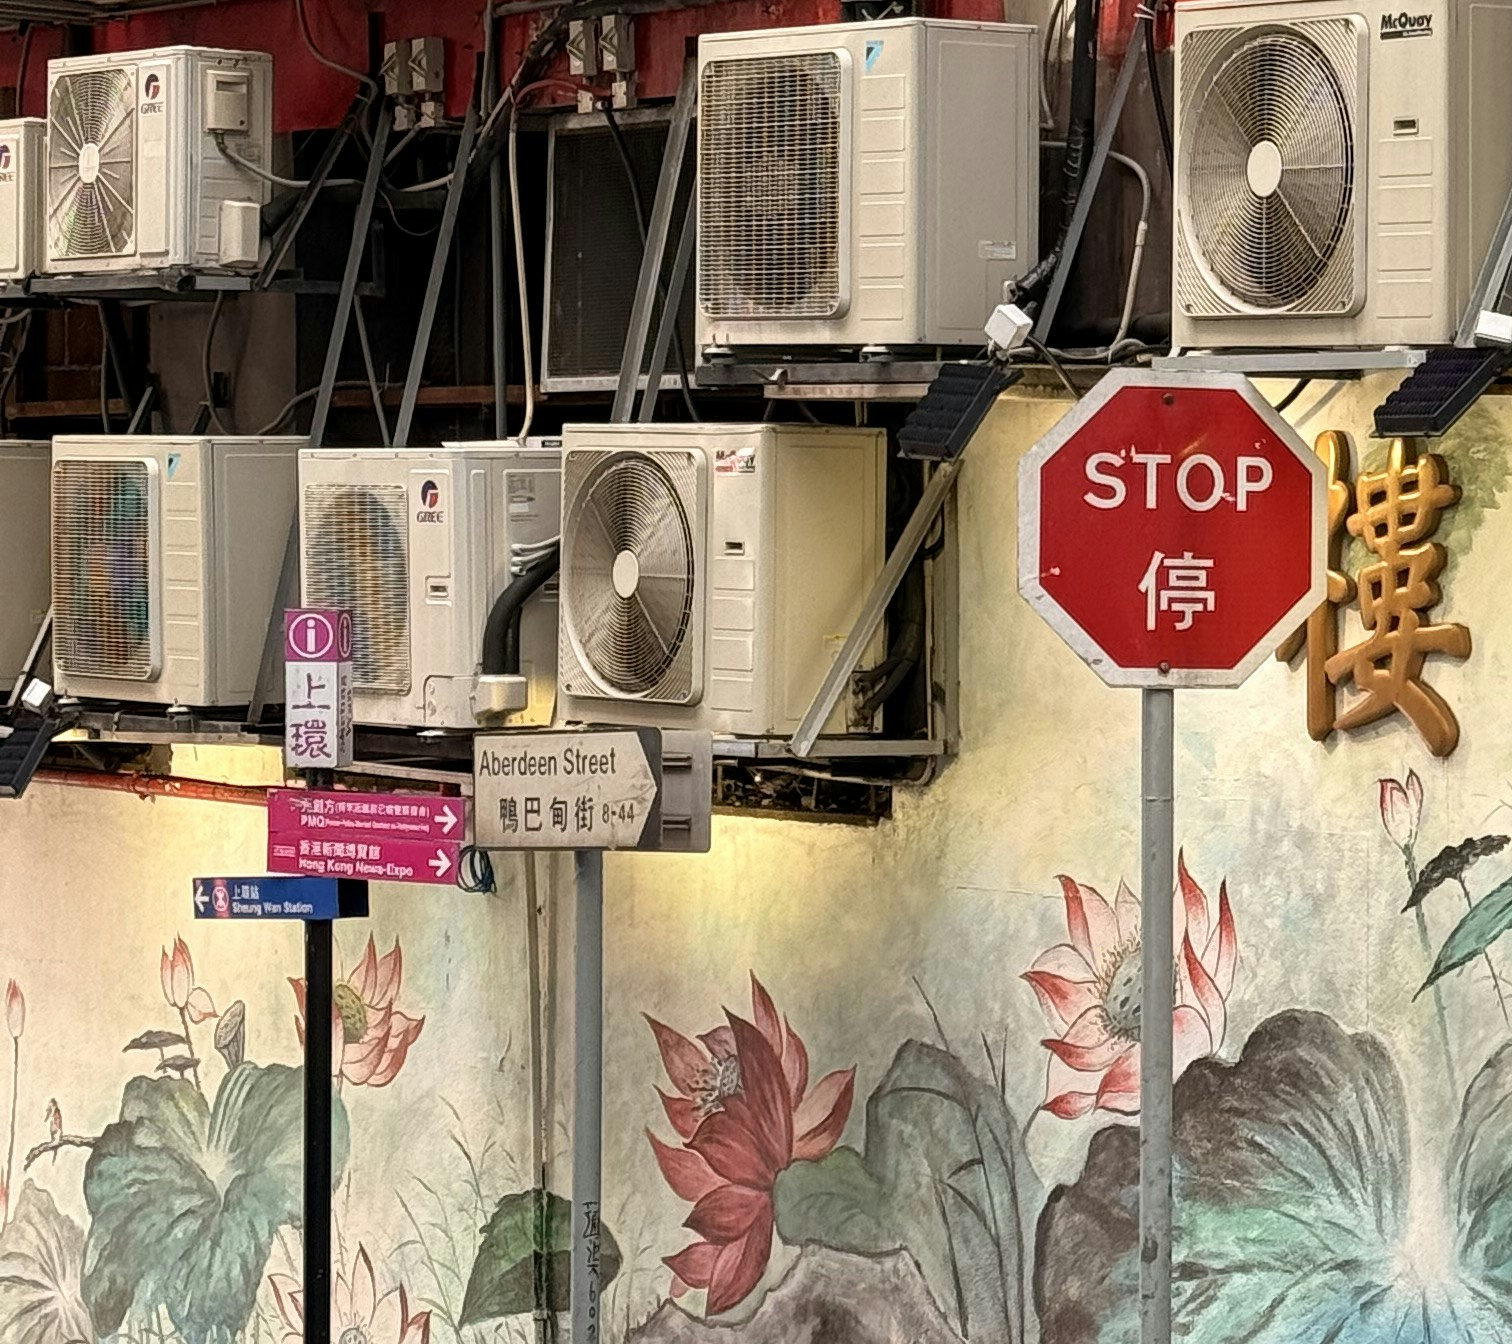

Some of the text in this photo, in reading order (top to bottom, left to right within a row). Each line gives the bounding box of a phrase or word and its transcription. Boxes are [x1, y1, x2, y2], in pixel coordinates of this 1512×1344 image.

[1380, 12, 1433, 31] McQuay
[1082, 451, 1274, 512] STOP
[416, 510, 445, 524] GREE
[1137, 550, 1216, 632] 停
[289, 671, 333, 759] 上環
[479, 746, 617, 777] Aberdeen Street
[499, 795, 595, 834] 鴨巴甸街
[299, 856, 325, 874] Hong
[326, 858, 354, 876] Kong
[263, 901, 282, 914] Wan
[283, 901, 314, 914] Station
